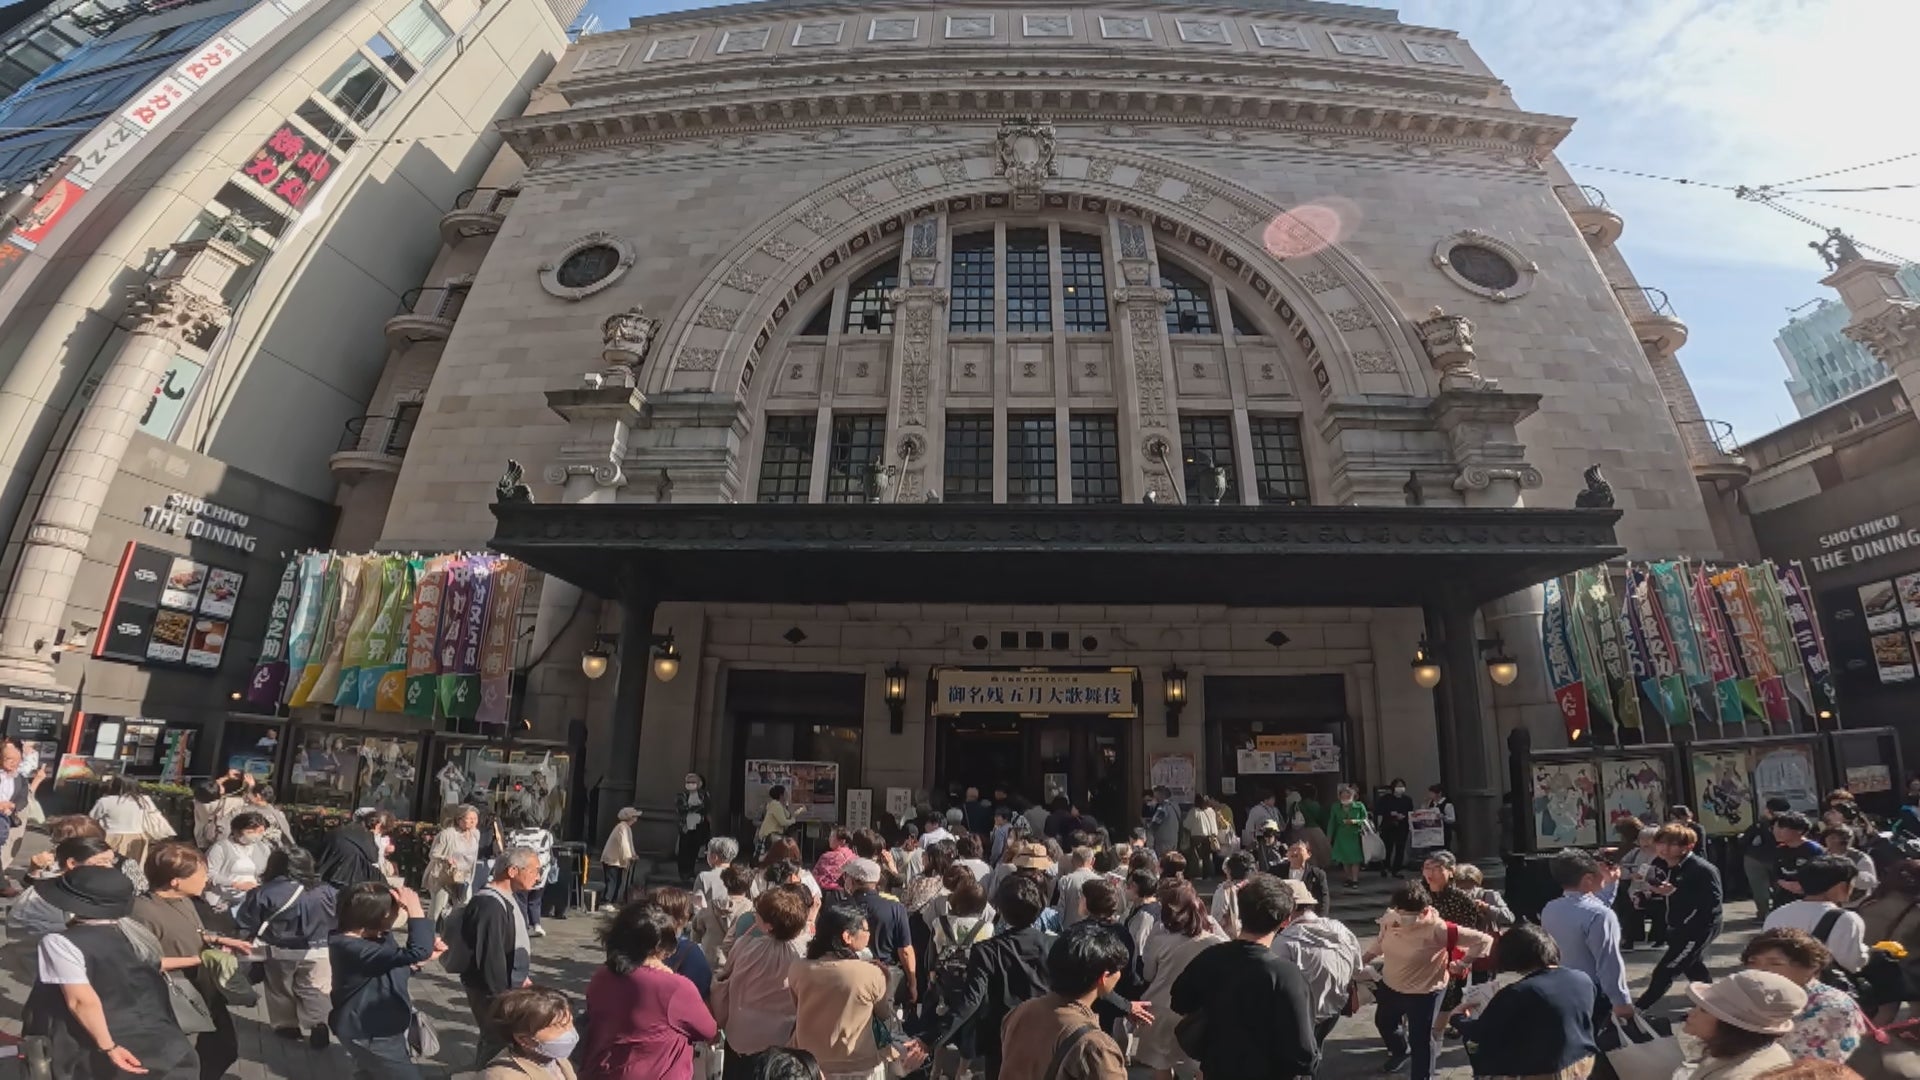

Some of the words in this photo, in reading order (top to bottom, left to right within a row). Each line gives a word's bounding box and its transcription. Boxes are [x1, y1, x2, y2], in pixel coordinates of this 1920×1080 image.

[132, 93, 171, 124] 力丸
[269, 127, 331, 181] 焼肉
[171, 493, 249, 527] SHOCHIKU
[148, 505, 187, 532] THE
[191, 519, 258, 552] DINING
[1819, 514, 1900, 549] SHOCHIKU
[1810, 551, 1849, 573] THE
[1851, 528, 1920, 563] DINING
[947, 685, 1122, 705] 御名残五月大歌舞伎
